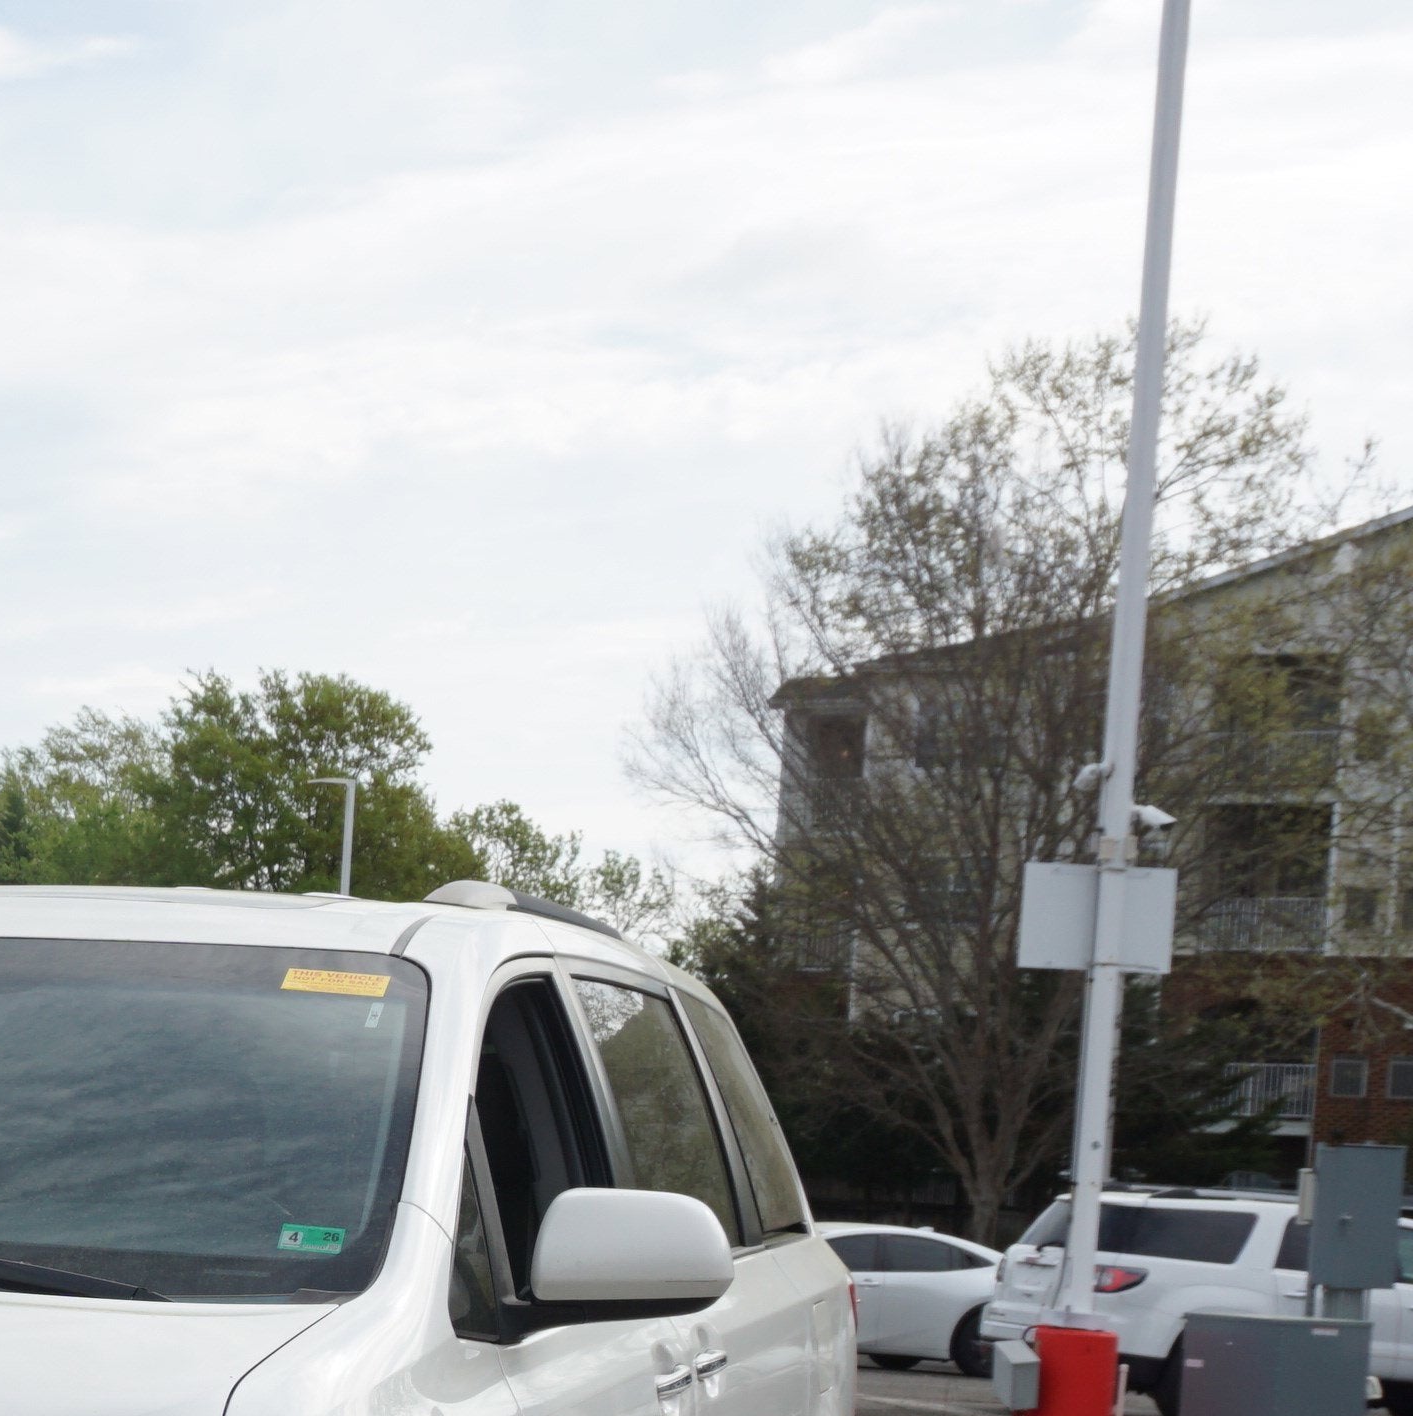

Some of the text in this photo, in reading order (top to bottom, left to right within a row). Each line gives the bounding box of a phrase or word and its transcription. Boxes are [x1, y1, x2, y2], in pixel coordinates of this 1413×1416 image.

[292, 969, 385, 982] THIS VEHICLE
[288, 1231, 340, 1243] 4 26
